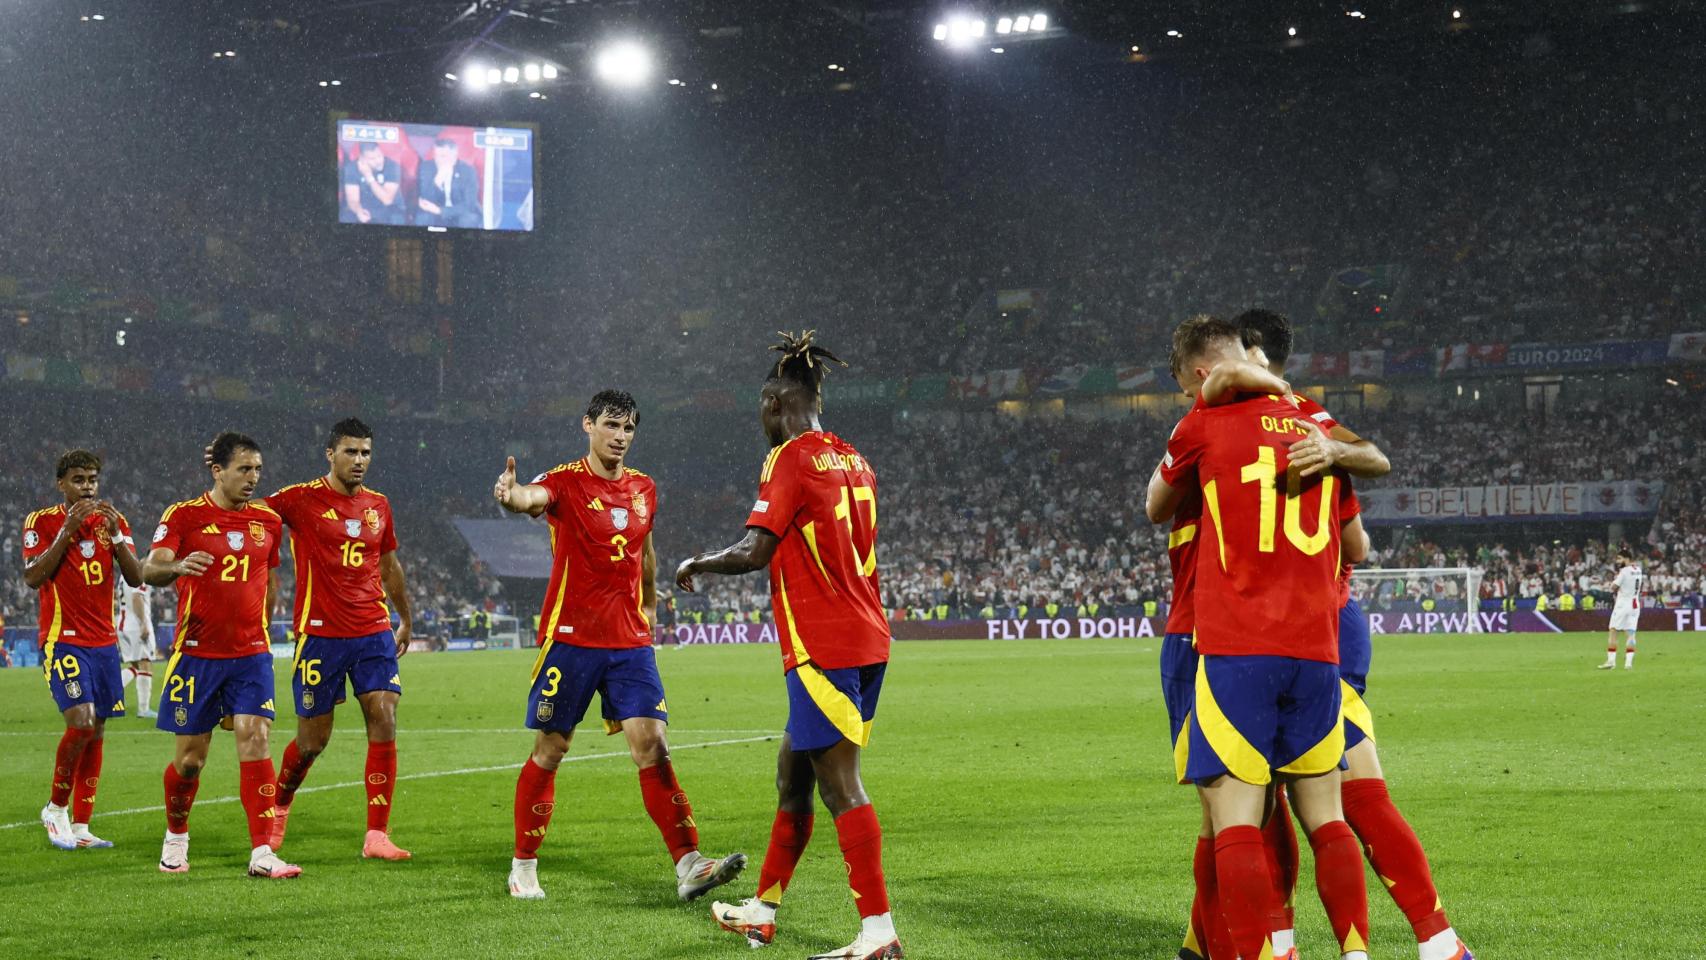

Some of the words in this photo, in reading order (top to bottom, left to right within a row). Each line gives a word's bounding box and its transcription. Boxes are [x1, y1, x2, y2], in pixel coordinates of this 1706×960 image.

[1507, 349, 1560, 365] EURO
[1562, 347, 1603, 363] 2024
[1241, 446, 1334, 556] 10
[1418, 485, 1580, 517] BELIEVE
[834, 485, 877, 577] 17
[340, 541, 366, 568] 16
[610, 534, 628, 561] 3
[80, 560, 104, 586] 19
[221, 554, 250, 582] 21
[675, 623, 749, 644] QATAR
[986, 619, 1028, 640] FLY
[1036, 618, 1071, 639] TO
[1078, 617, 1155, 638] DOHA
[1674, 608, 1706, 632] FL
[53, 654, 80, 681] 19
[298, 659, 322, 686] 16
[169, 674, 195, 704] 21
[541, 666, 562, 697] 3
